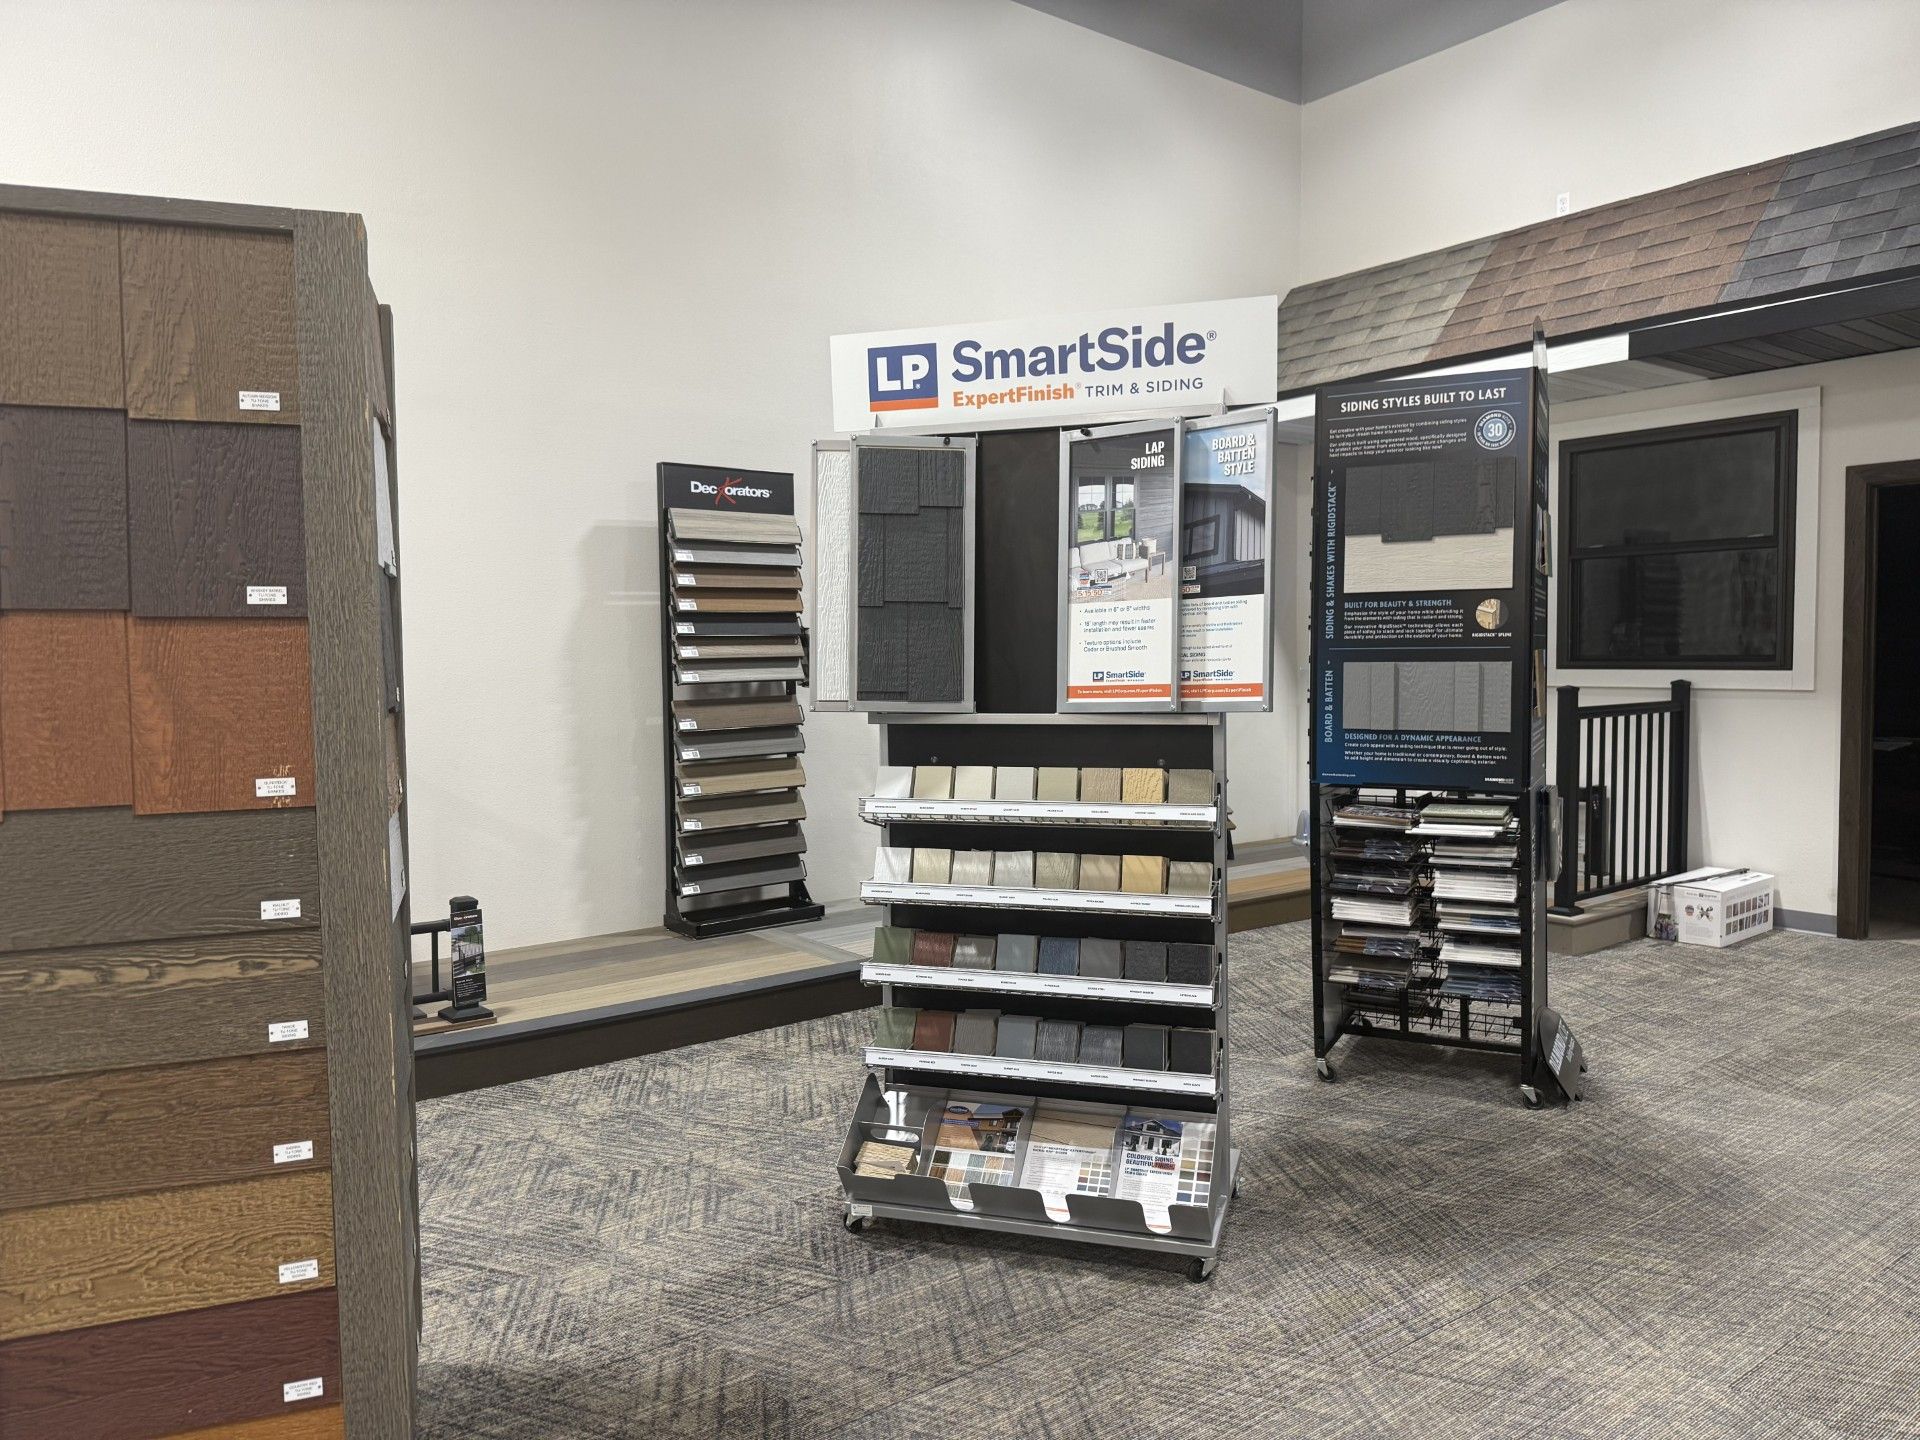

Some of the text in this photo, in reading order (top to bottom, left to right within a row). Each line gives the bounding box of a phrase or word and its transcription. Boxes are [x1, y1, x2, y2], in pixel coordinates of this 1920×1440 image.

[875, 354, 930, 391] LP
[1085, 384, 1123, 399] TRIM
[1130, 382, 1140, 396] &
[1146, 378, 1204, 393] SIDING
[1341, 388, 1506, 413] SIDING STYLES BUILT TO LAST
[1488, 423, 1502, 437] 30
[1145, 440, 1165, 455] LAP
[1212, 433, 1256, 451] BOARD &
[1130, 455, 1165, 470] SIDING
[1217, 446, 1256, 464] BATTEN
[1224, 460, 1254, 476] STYLE
[1327, 539, 1335, 563] WITH
[1326, 565, 1335, 597] SHAKES
[1326, 608, 1334, 639] SIDING
[1193, 670, 1233, 678] SmartSide
[1325, 670, 1334, 702] BATTEN
[1325, 713, 1333, 742] BOARD
[1125, 1159, 1154, 1167] BEAUTIFUL
[1126, 1153, 1153, 1161] COLORFUL
